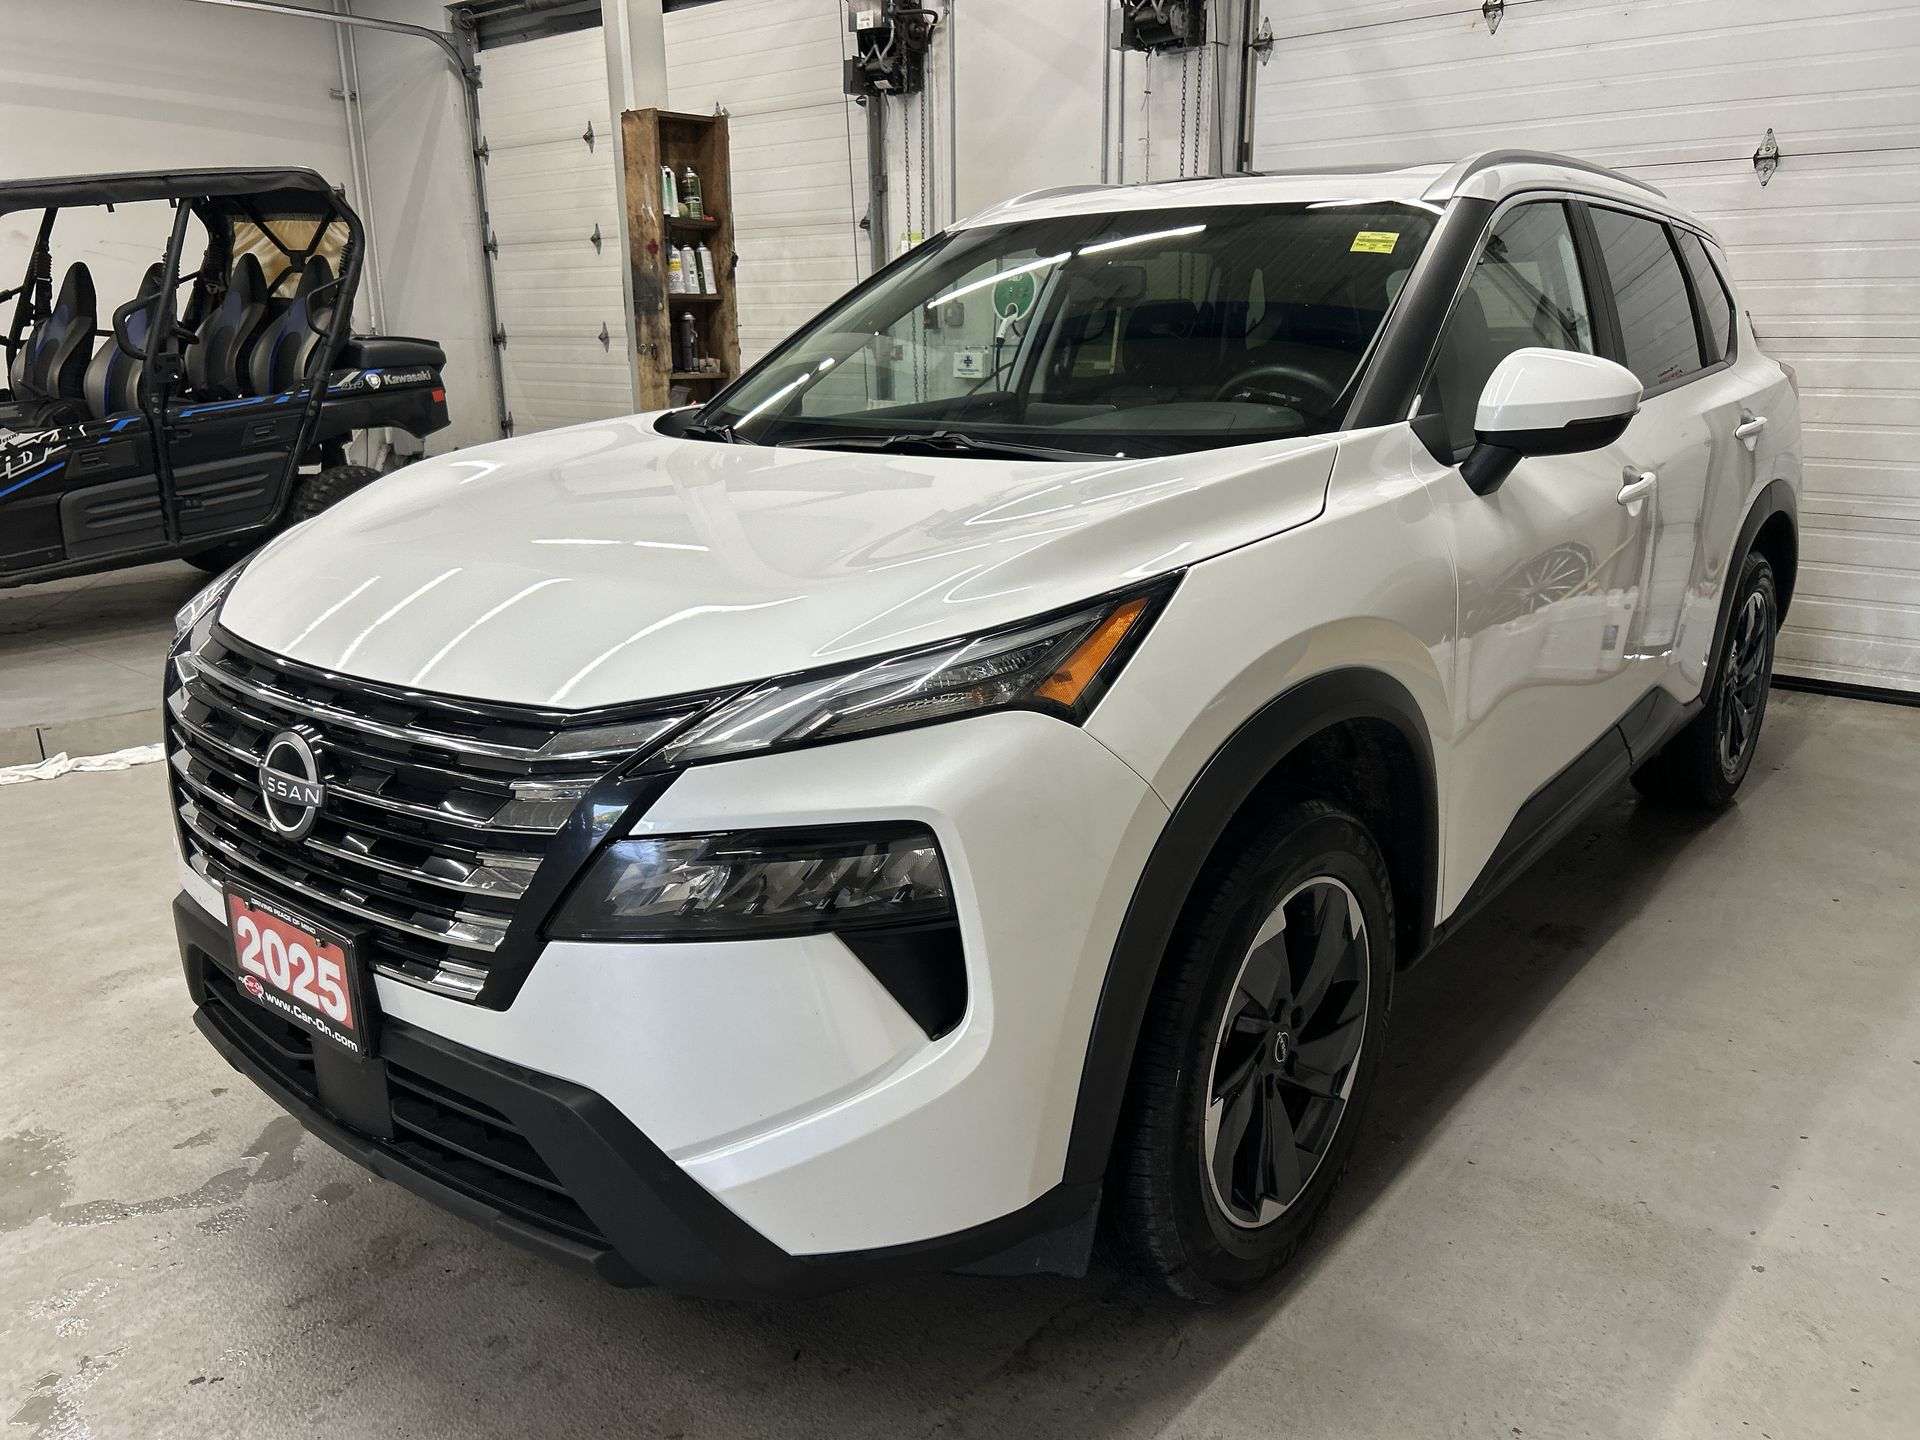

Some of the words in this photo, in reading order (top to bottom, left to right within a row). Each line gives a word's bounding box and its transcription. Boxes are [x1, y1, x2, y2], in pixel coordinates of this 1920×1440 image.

[383, 370, 432, 385] Kawasaki
[267, 776, 320, 804] SSAN
[237, 915, 348, 1022] 2025
[264, 991, 359, 1053] www.Car-On.com
